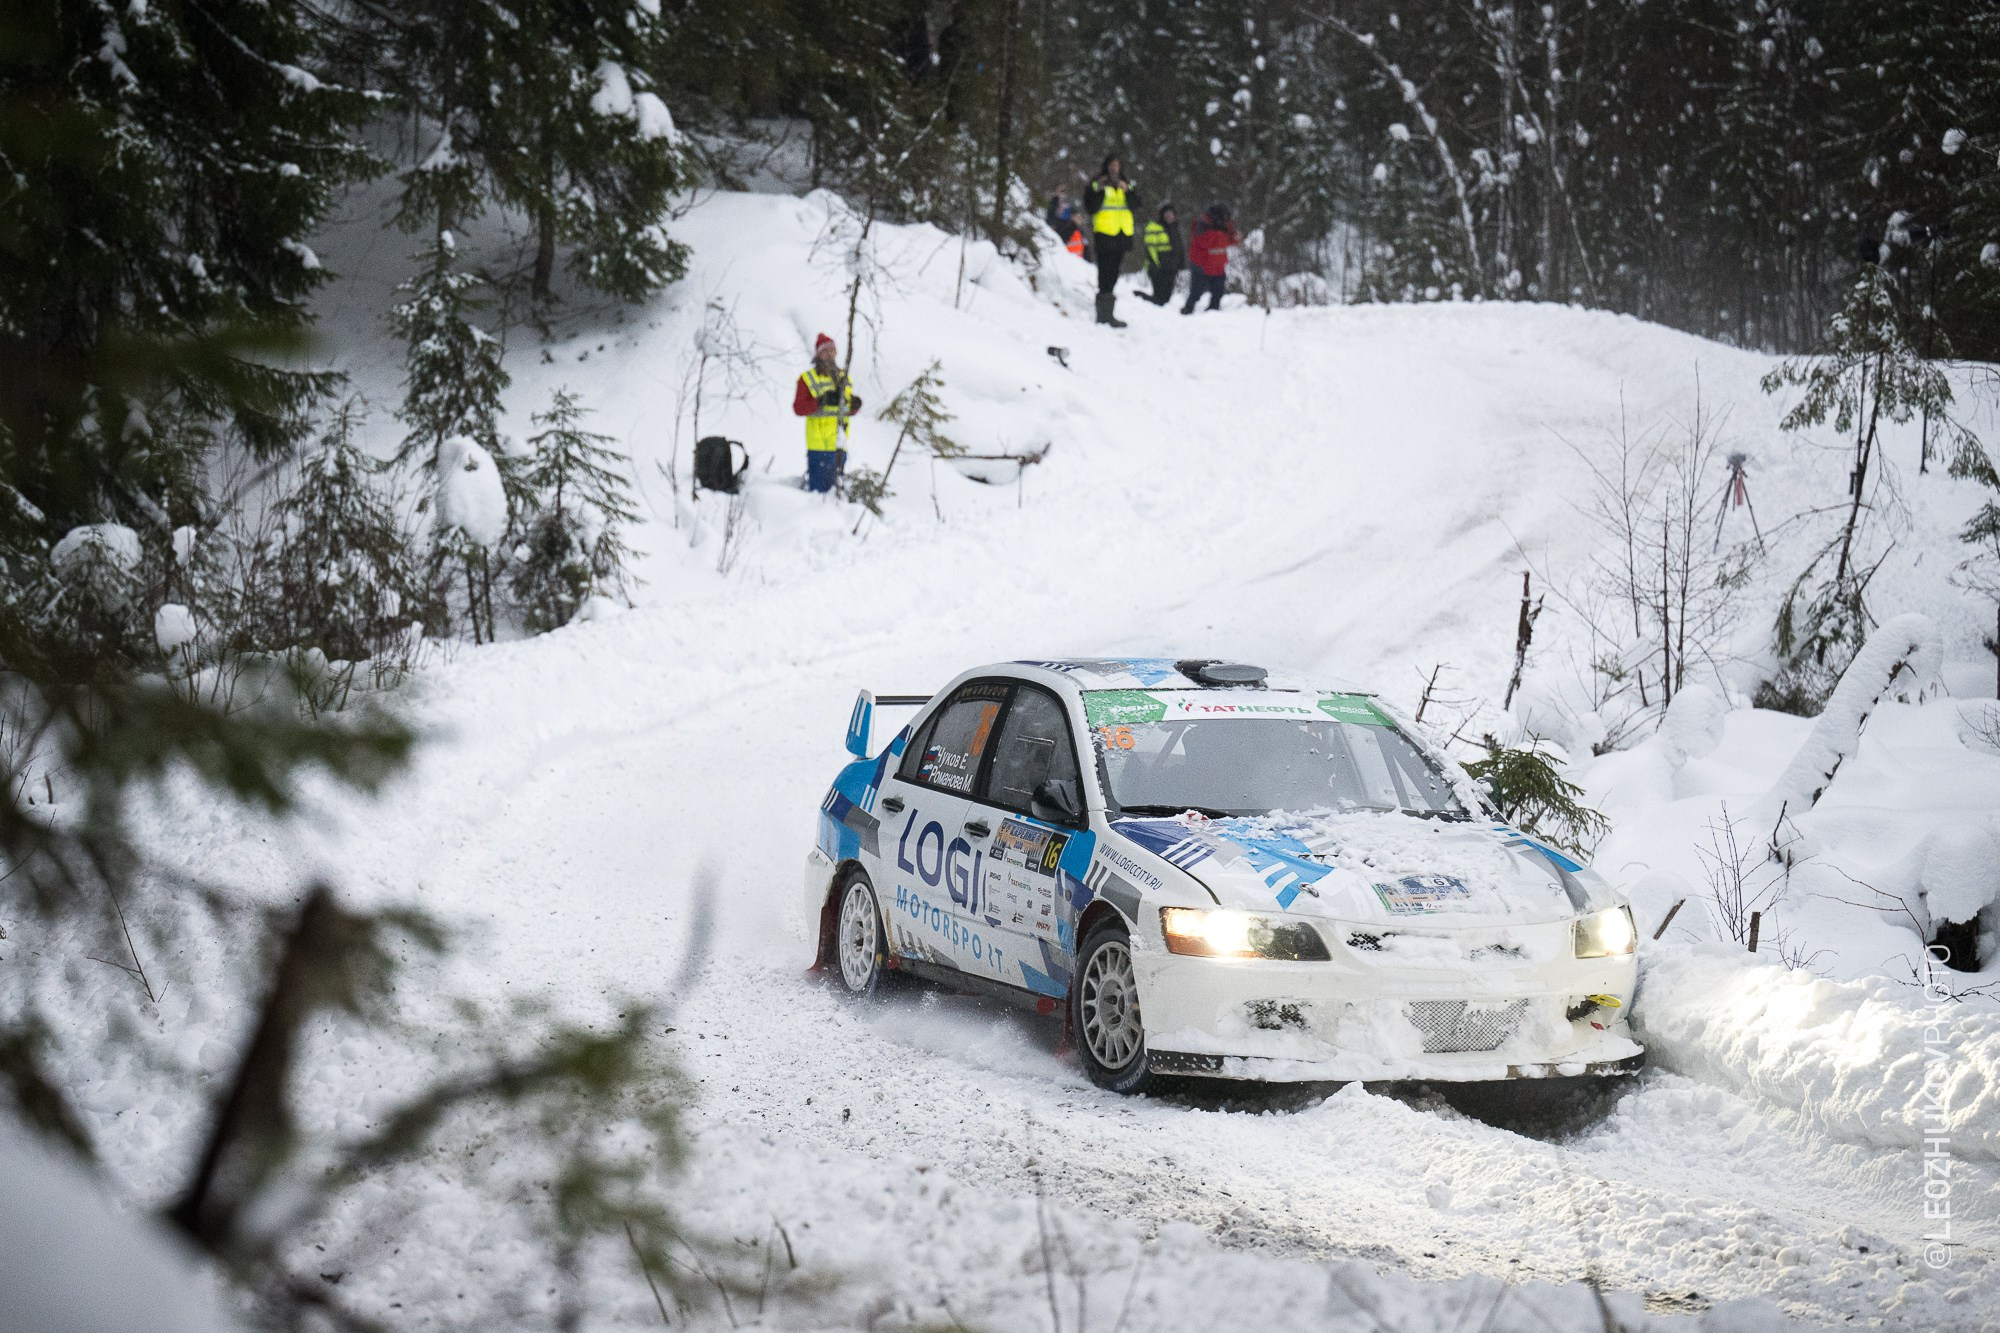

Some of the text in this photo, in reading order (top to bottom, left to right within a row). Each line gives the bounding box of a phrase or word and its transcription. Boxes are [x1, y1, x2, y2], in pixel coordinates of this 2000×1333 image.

[1200, 704, 1312, 714] ТАТНЕФТЬ
[1099, 726, 1135, 750] 16
[1044, 841, 1062, 868] 16
[1099, 843, 1163, 891] WWW.LOGICCITY.RU
